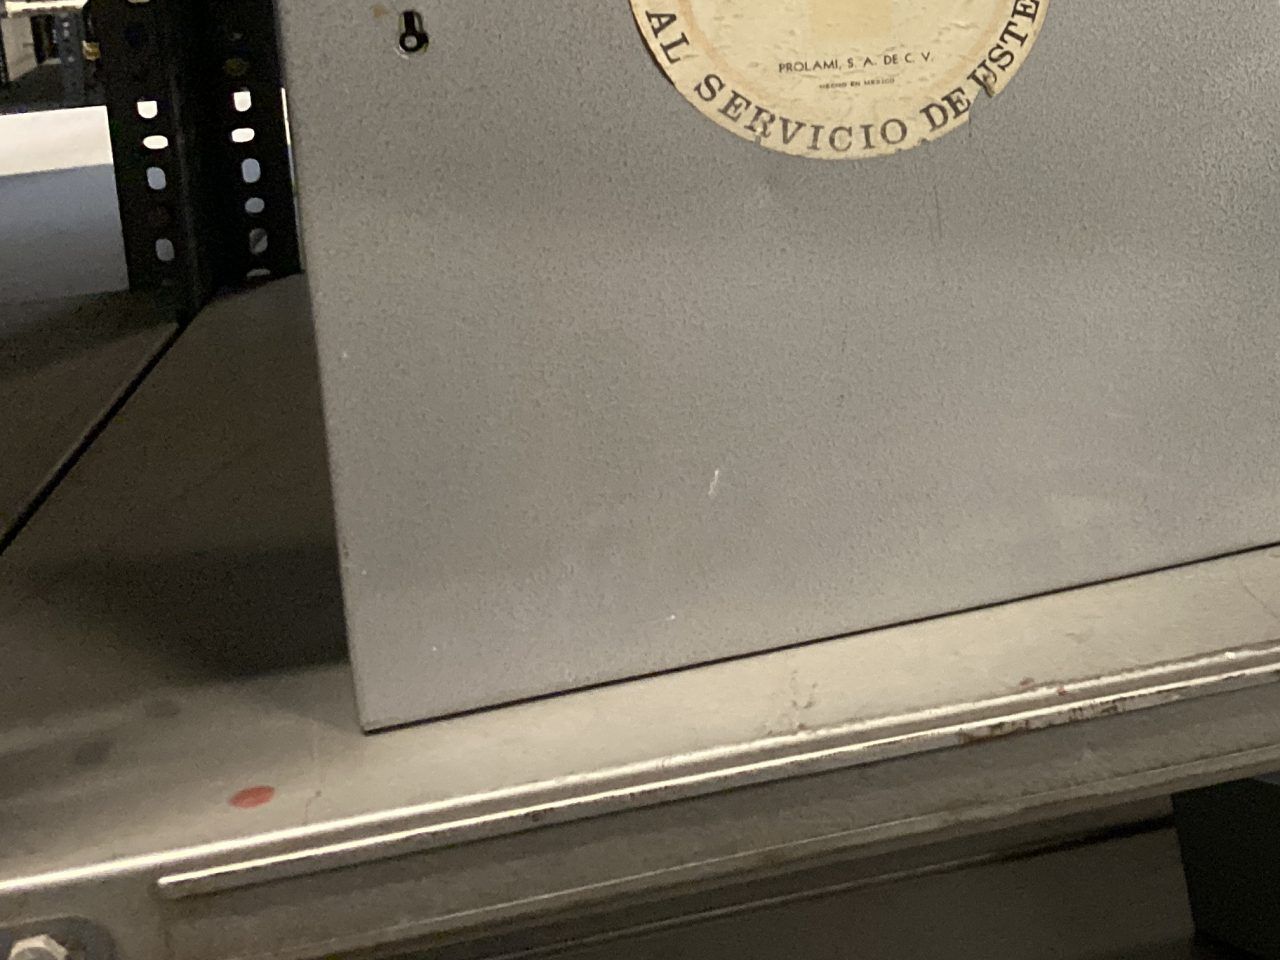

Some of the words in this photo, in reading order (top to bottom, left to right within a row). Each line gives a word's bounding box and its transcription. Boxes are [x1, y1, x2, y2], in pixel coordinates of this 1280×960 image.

[778, 58, 842, 73] PROLAMI,
[883, 54, 899, 66] DE
[645, 9, 692, 64] AL
[694, 73, 908, 152] SERVICIO
[920, 87, 971, 132] DE
[850, 80, 861, 88] EN
